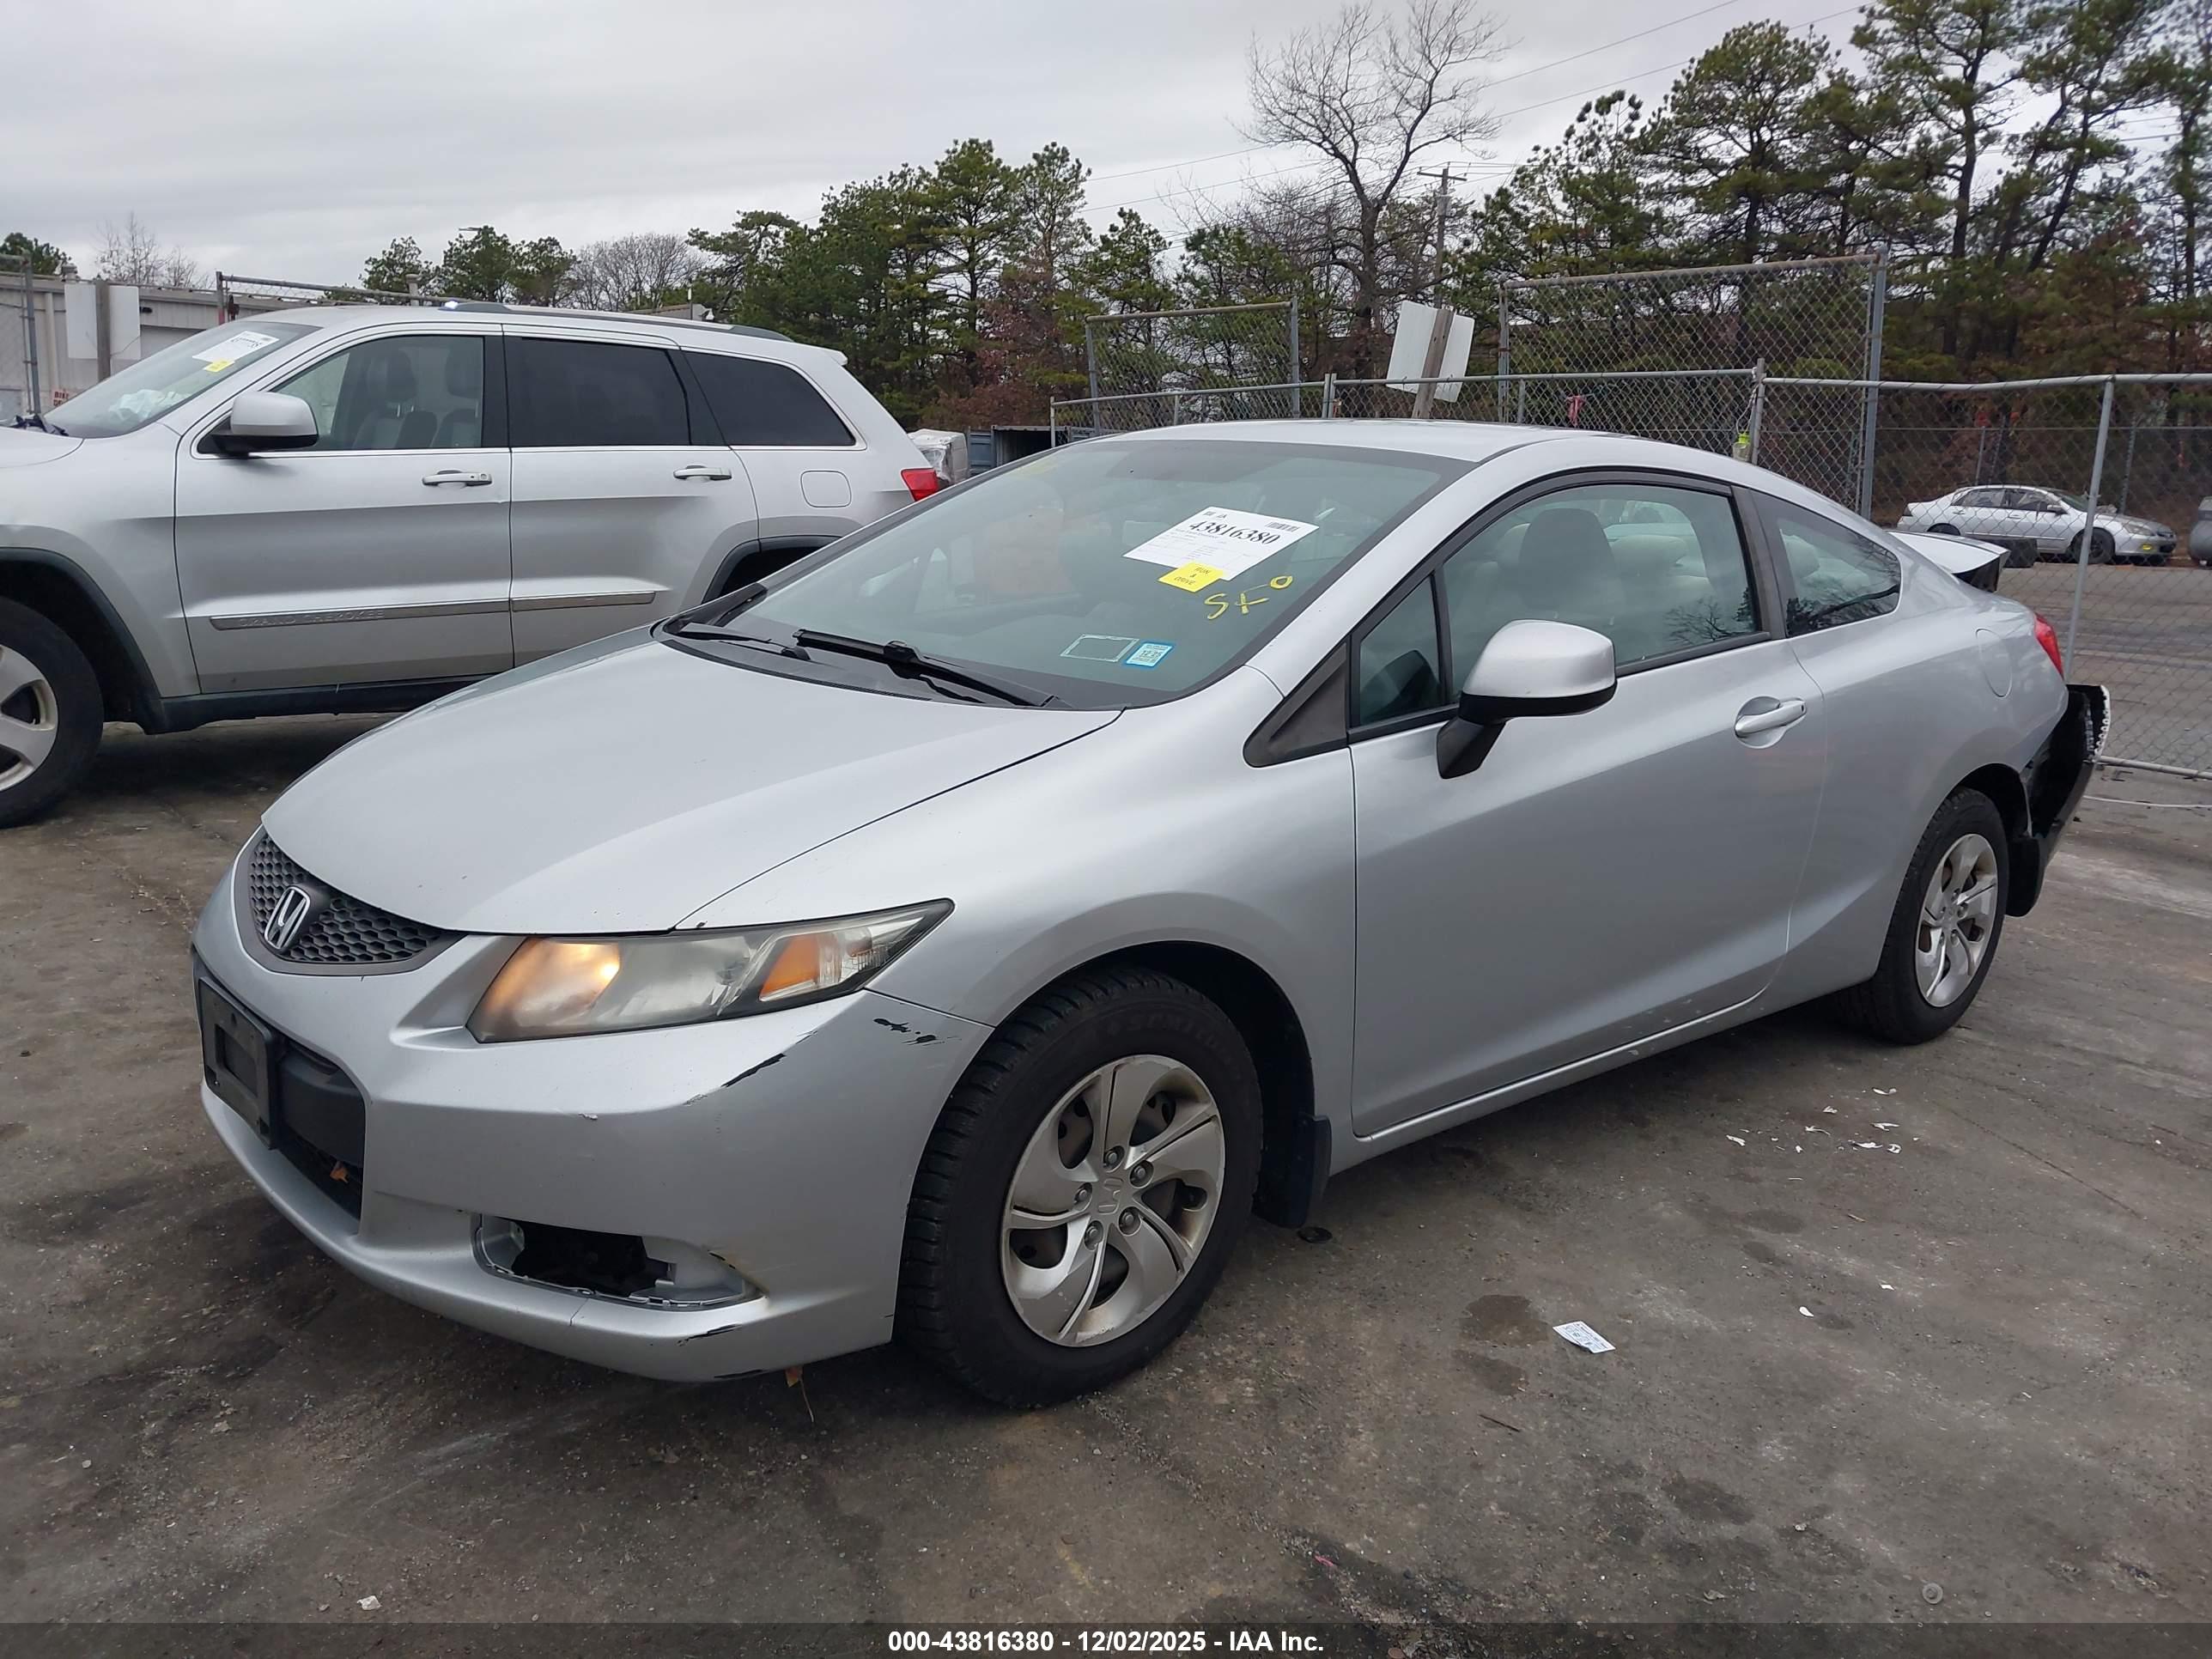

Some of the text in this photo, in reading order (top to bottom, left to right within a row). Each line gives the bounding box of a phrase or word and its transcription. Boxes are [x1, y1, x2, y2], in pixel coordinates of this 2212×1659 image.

[1189, 520, 1281, 545] 43816380
[1194, 566, 1212, 575] RUN
[1174, 576, 1196, 586] DRIVE
[304, 610, 386, 623] CHEROKEE
